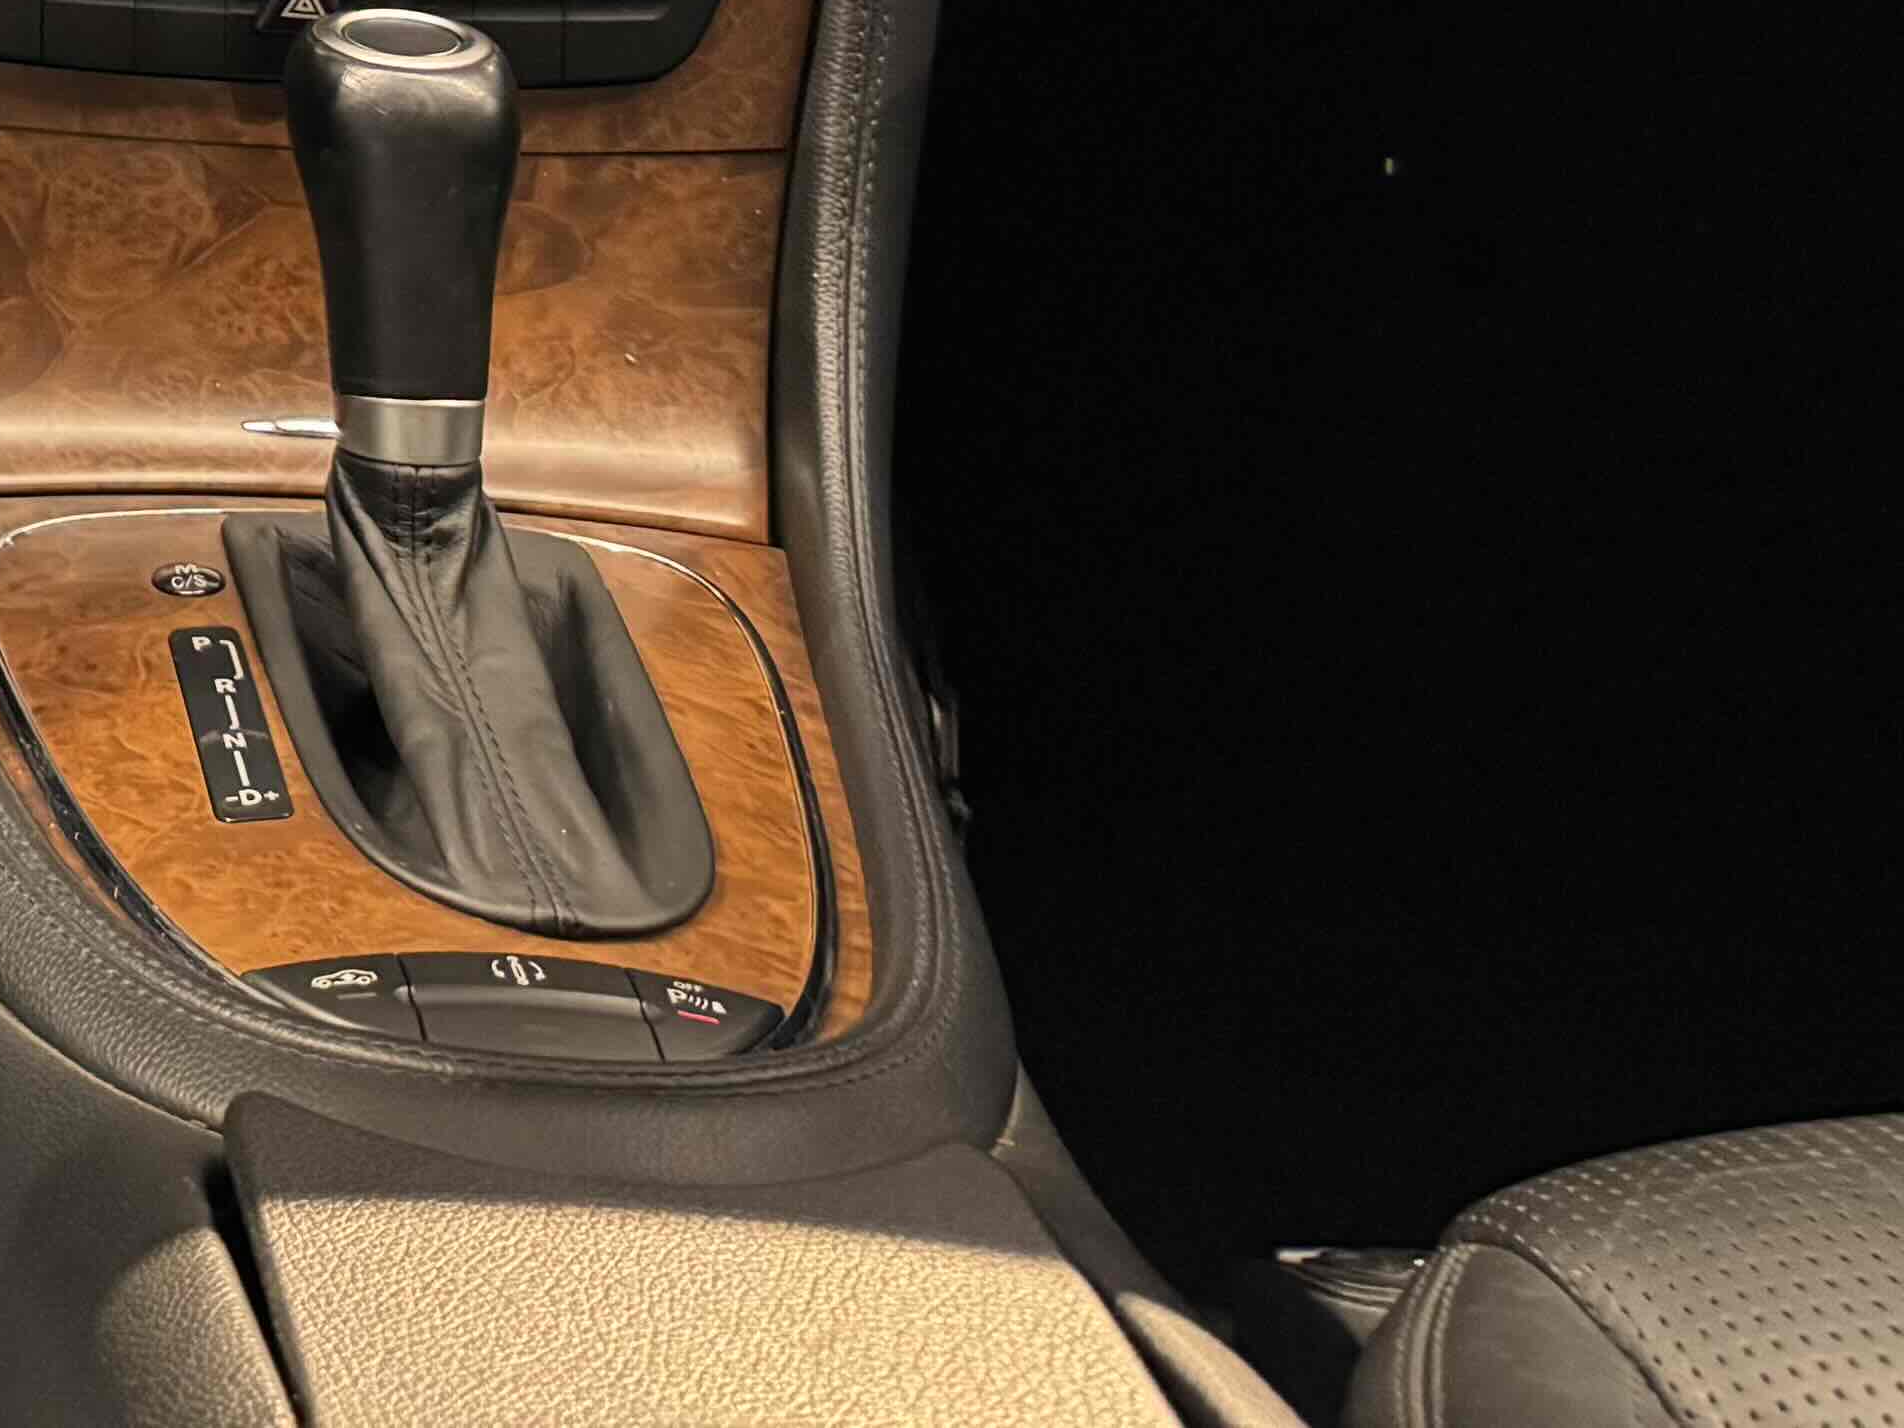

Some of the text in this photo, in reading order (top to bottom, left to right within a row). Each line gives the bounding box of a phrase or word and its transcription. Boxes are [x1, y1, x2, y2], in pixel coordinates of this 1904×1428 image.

[191, 636, 211, 652] P
[214, 677, 236, 694] R
[223, 732, 248, 749] N
